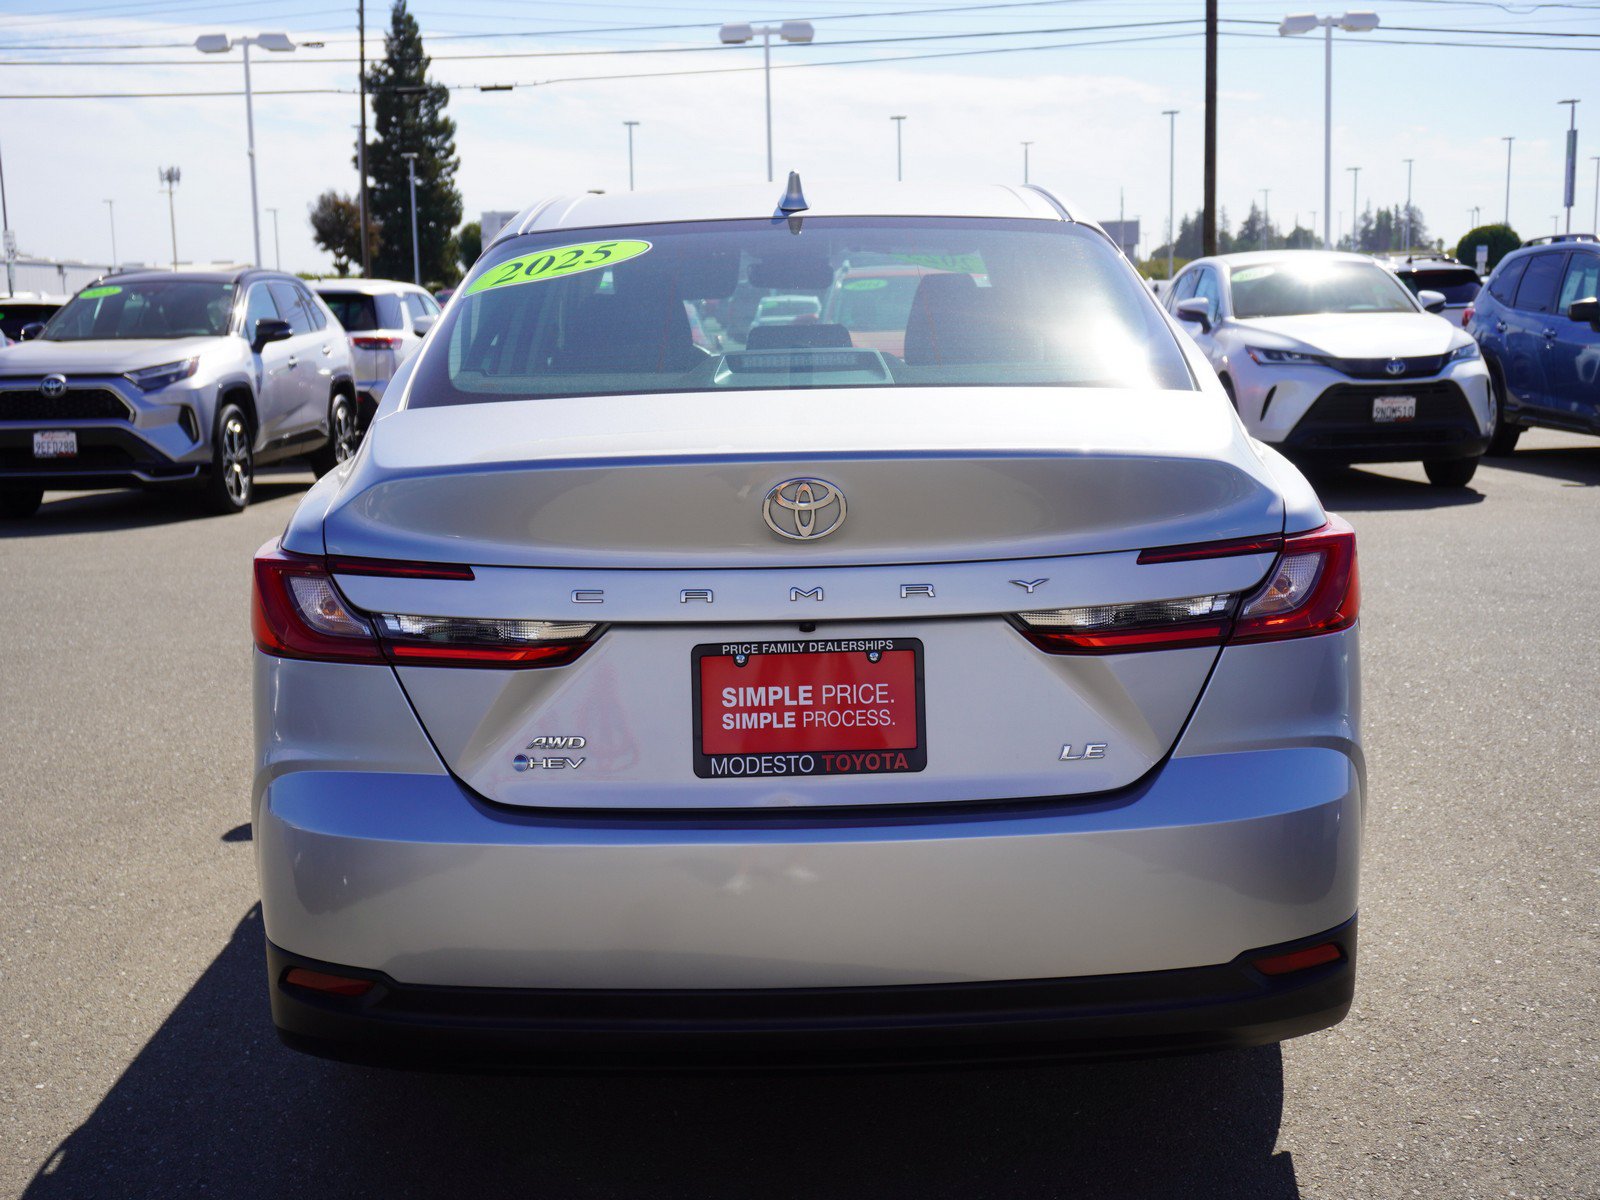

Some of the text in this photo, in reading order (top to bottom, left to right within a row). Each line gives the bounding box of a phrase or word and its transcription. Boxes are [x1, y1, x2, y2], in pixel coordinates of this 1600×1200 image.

[491, 243, 617, 286] 2025
[571, 578, 1050, 603] CAMRY
[722, 640, 894, 654] PRICE FAMILY DEALERSHIPS
[722, 684, 895, 708] SIMPLE PRICE.
[722, 709, 896, 730] SIMPLE PROCESS.
[526, 736, 586, 749] AWD
[1058, 743, 1107, 761] LE
[529, 757, 586, 769] HEV
[711, 752, 909, 775] MODESTO TOYOTA
